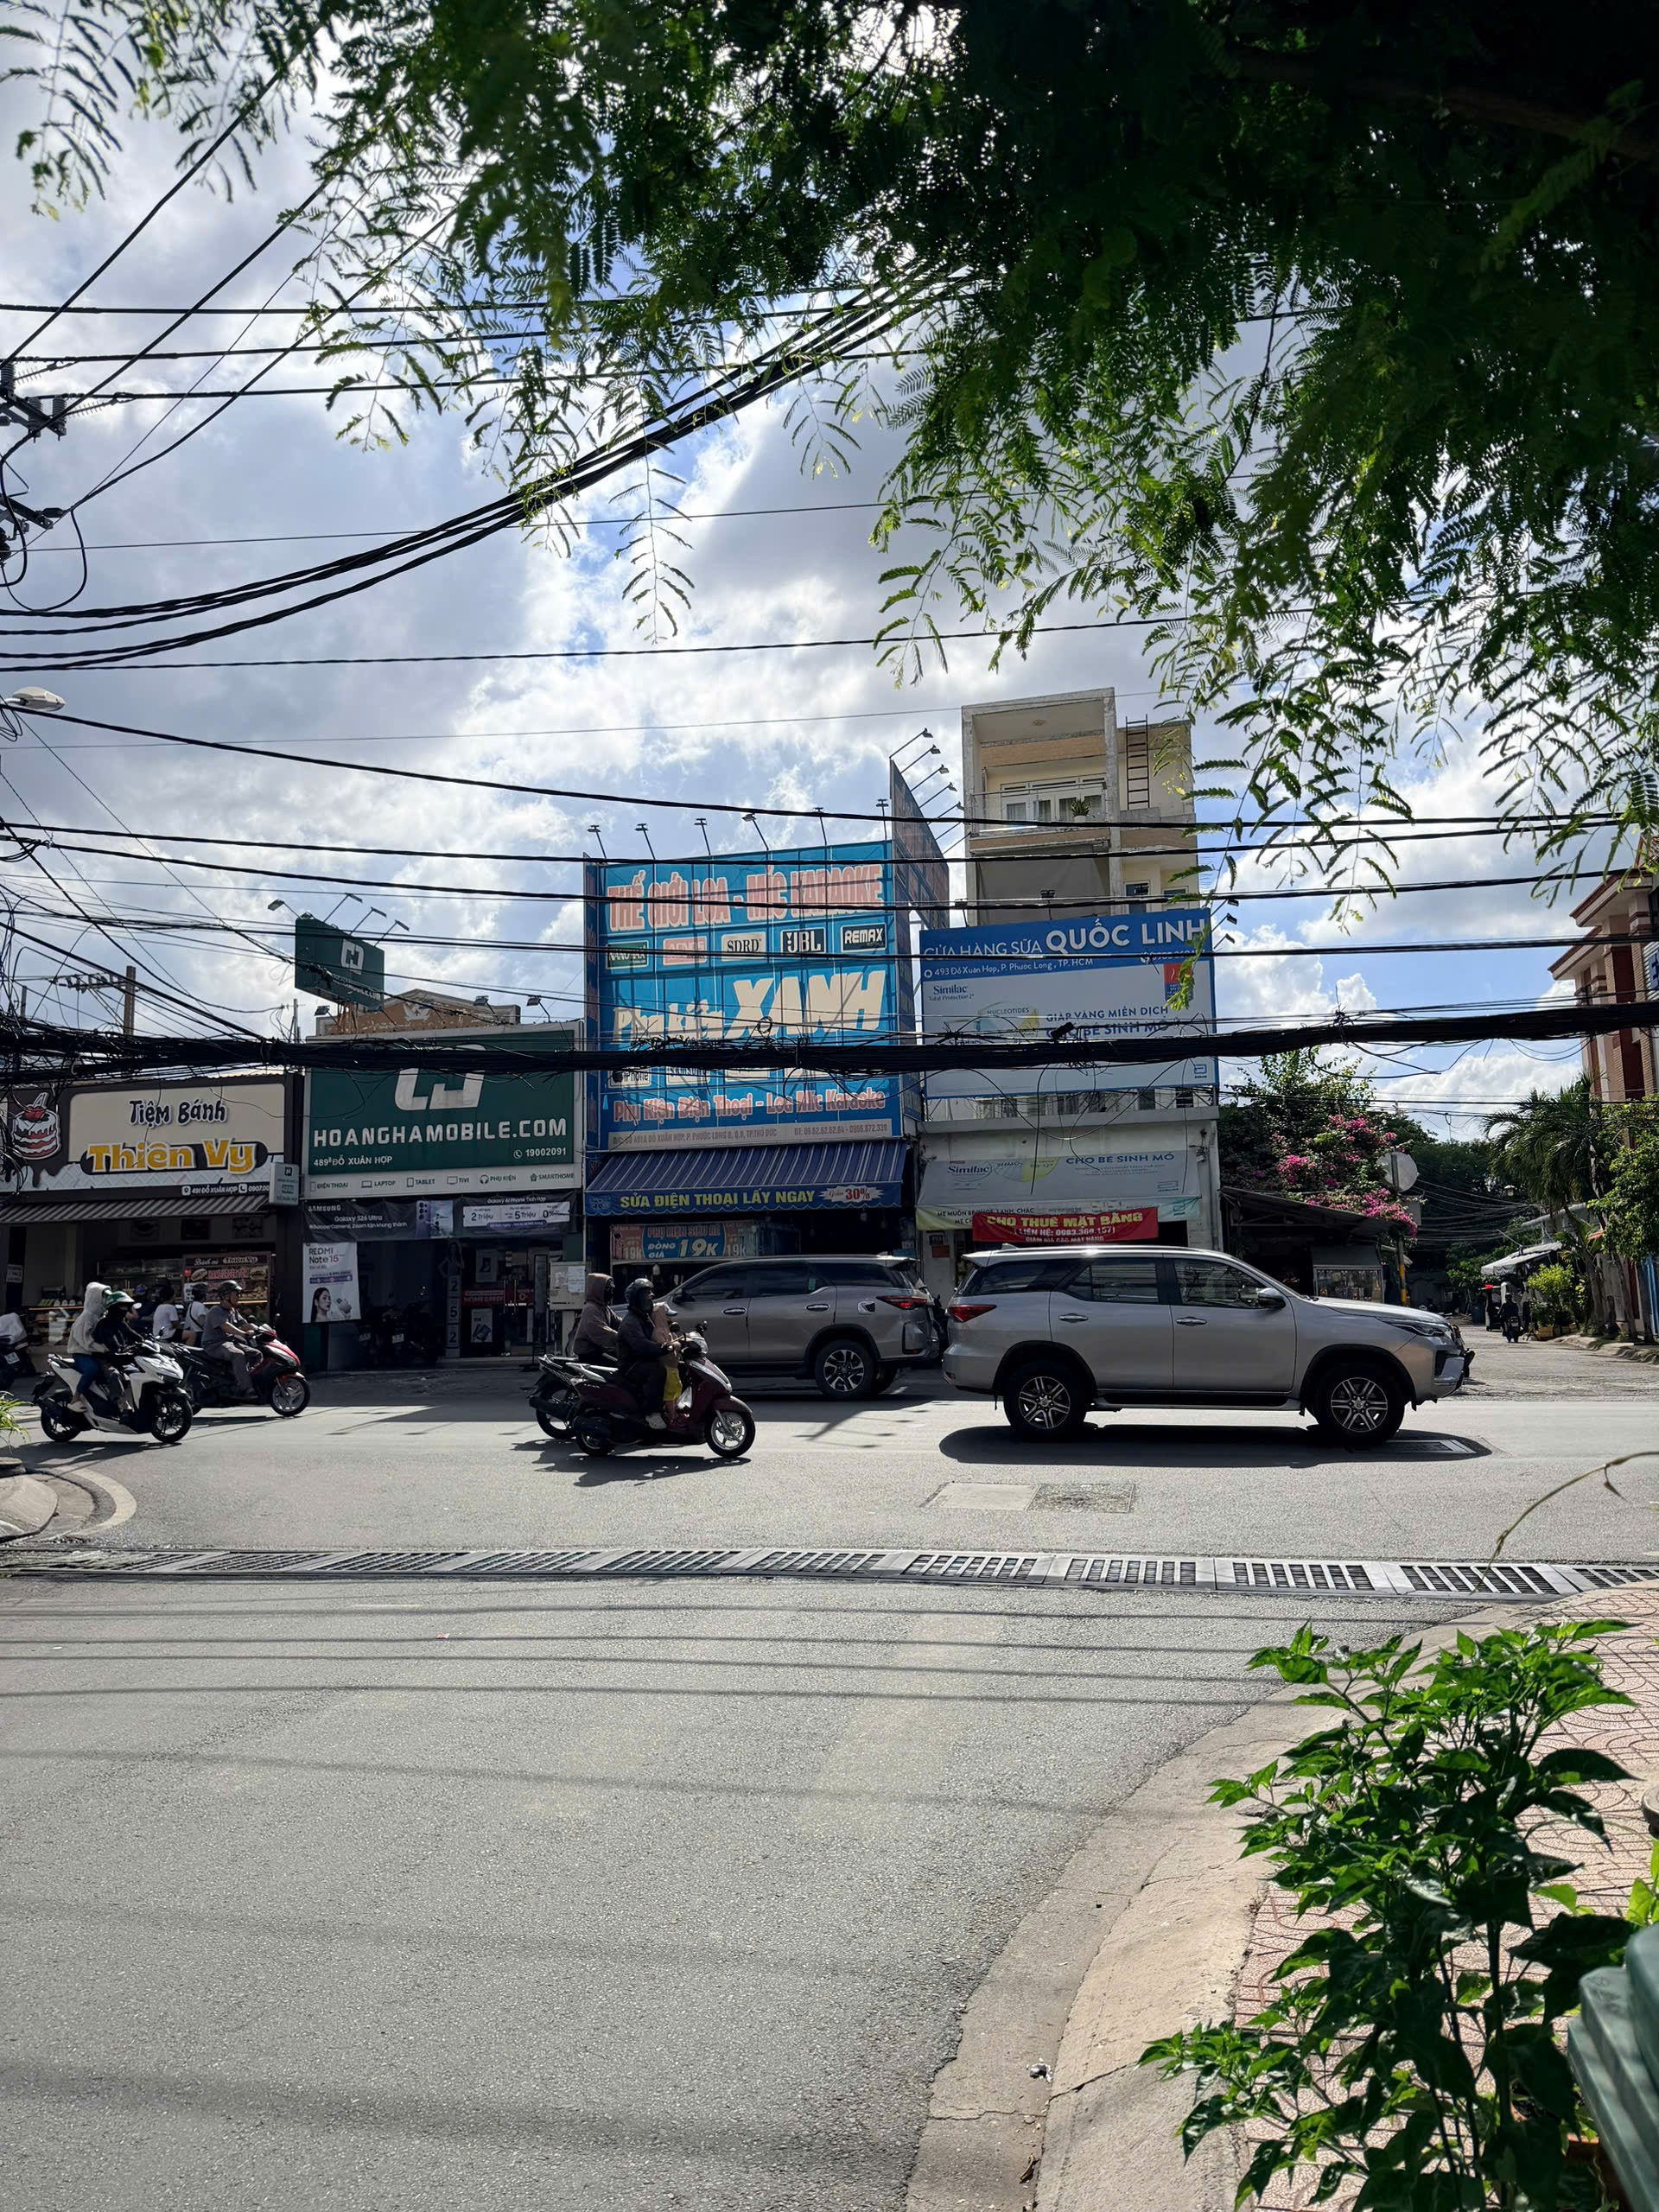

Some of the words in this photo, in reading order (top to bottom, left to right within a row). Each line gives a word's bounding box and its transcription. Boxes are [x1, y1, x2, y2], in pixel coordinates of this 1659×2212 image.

[648, 872, 689, 928] GIỚI
[692, 877, 731, 925] LOA
[791, 865, 884, 918] KARAOKE
[786, 931, 821, 954] JBL
[844, 928, 884, 944] REMAX
[1010, 938, 1042, 955] SỮA
[1046, 918, 1130, 954] QUỐC
[1141, 918, 1205, 945] LINH
[933, 983, 968, 995] Similac
[726, 969, 886, 1039] XANH
[1140, 1006, 1168, 1017] DỊCH
[129, 1099, 172, 1128] Tiệm
[178, 1098, 229, 1126] Bánh
[613, 1100, 641, 1127] Phụ
[643, 1098, 675, 1125] Kiện
[677, 1096, 711, 1123] Điện
[713, 1092, 753, 1121] Thoại
[766, 1092, 793, 1115] Loa
[826, 1087, 885, 1112] Karaoke
[313, 1117, 567, 1147] HOANGHAMOBILE.COM
[86, 1141, 196, 1173] Thiên
[201, 1137, 258, 1175] Vy
[347, 1154, 372, 1165] XUÂN
[374, 1154, 393, 1165] HỢP
[524, 1147, 567, 1158] 19002091
[1065, 1156, 1095, 1165] CHO
[1116, 1154, 1148, 1163] SINH
[947, 1165, 990, 1174] Similac
[620, 1192, 651, 1208] SỬA
[654, 1192, 690, 1208] ĐIỆN
[694, 1192, 739, 1207] THOẠI
[742, 1187, 771, 1204] LẤY
[775, 1190, 816, 1203] NGAY
[845, 1187, 870, 1200] 30%
[308, 1204, 341, 1212] SAMSUNG
[986, 1217, 1017, 1227] CHO
[1020, 1216, 1058, 1228] THUÊ
[1063, 1214, 1096, 1229] MẶT
[308, 1247, 334, 1255] REDMI
[309, 1255, 328, 1264] Note
[329, 1255, 340, 1263] 15
